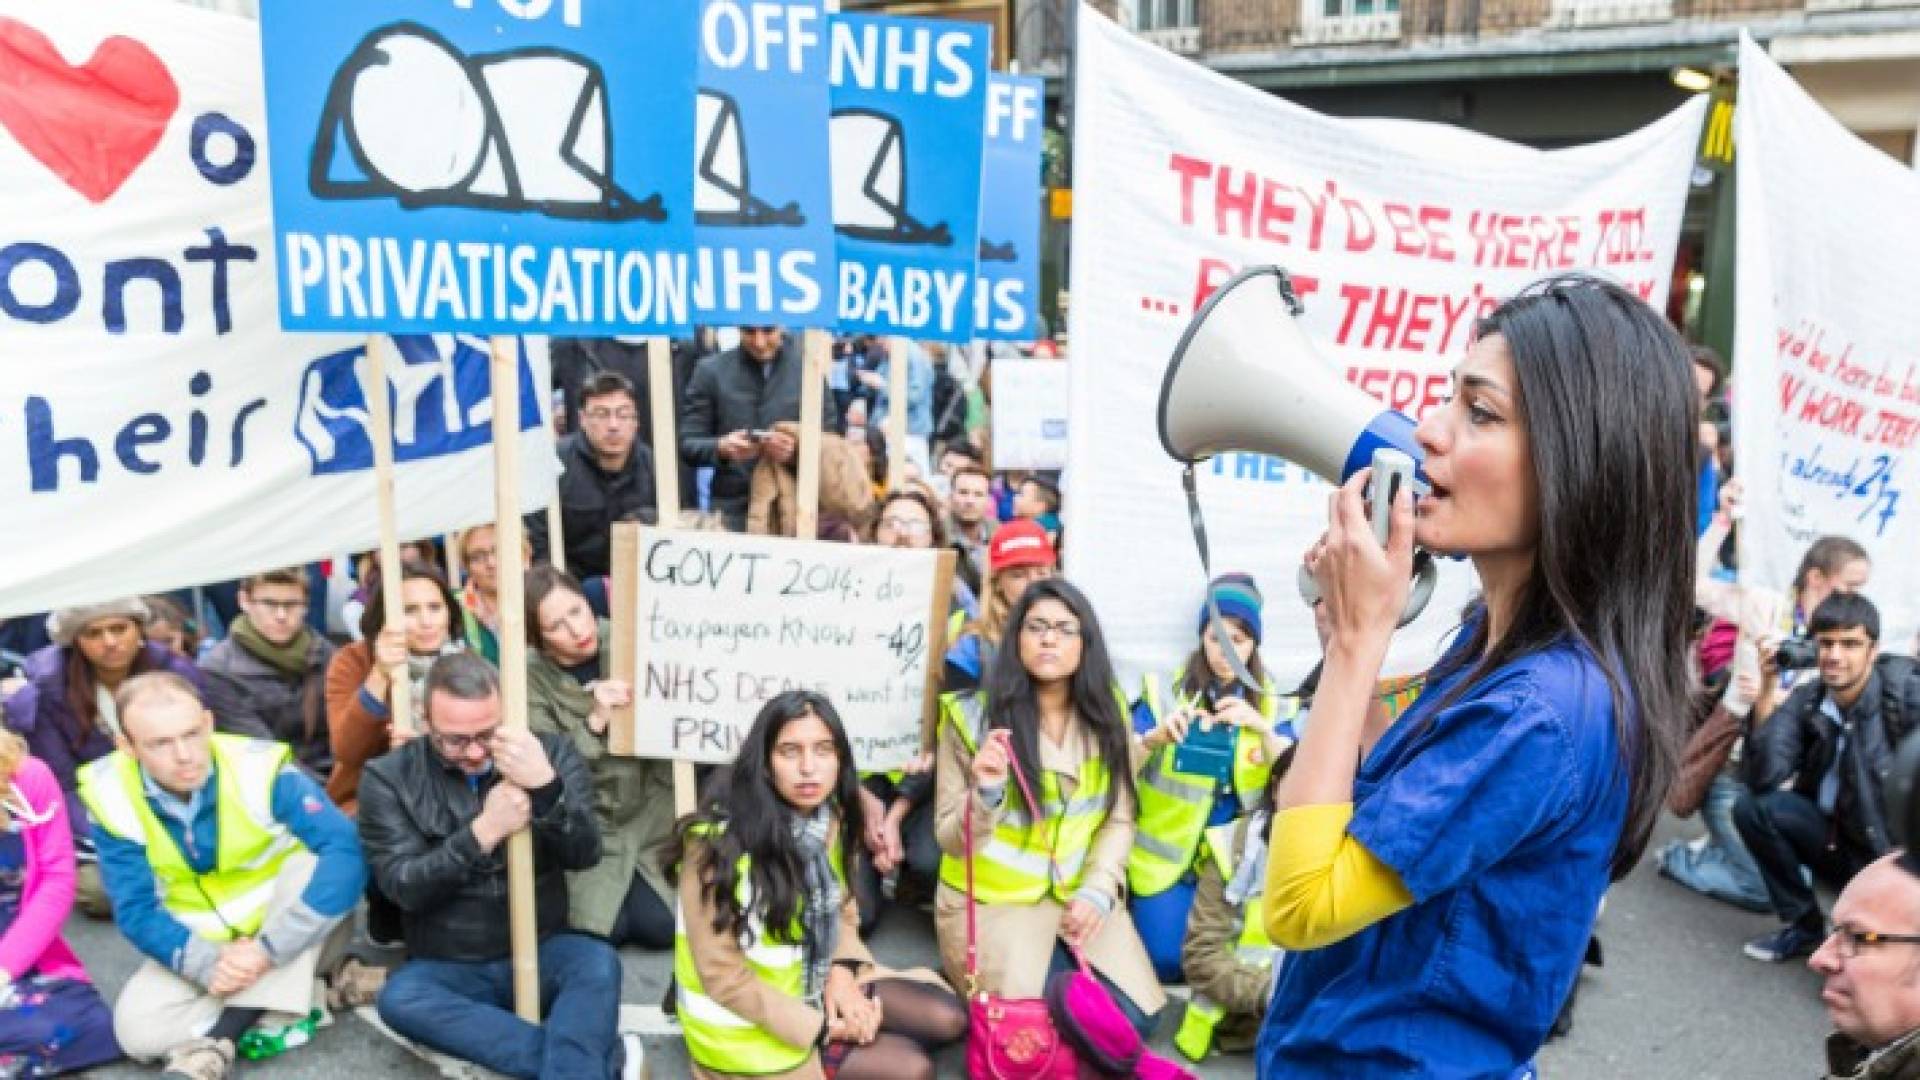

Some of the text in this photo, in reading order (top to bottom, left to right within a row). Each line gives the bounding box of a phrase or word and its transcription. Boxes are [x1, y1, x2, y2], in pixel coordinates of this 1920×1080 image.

[701, 0, 818, 72] OFF
[828, 22, 974, 98] NHS
[1168, 152, 1376, 252] THEY'D
[1382, 202, 1457, 264] BE
[1468, 208, 1580, 269] HERE
[285, 231, 689, 326] PRIVATISATION
[838, 260, 967, 332] BABY
[645, 660, 720, 704] NHS
